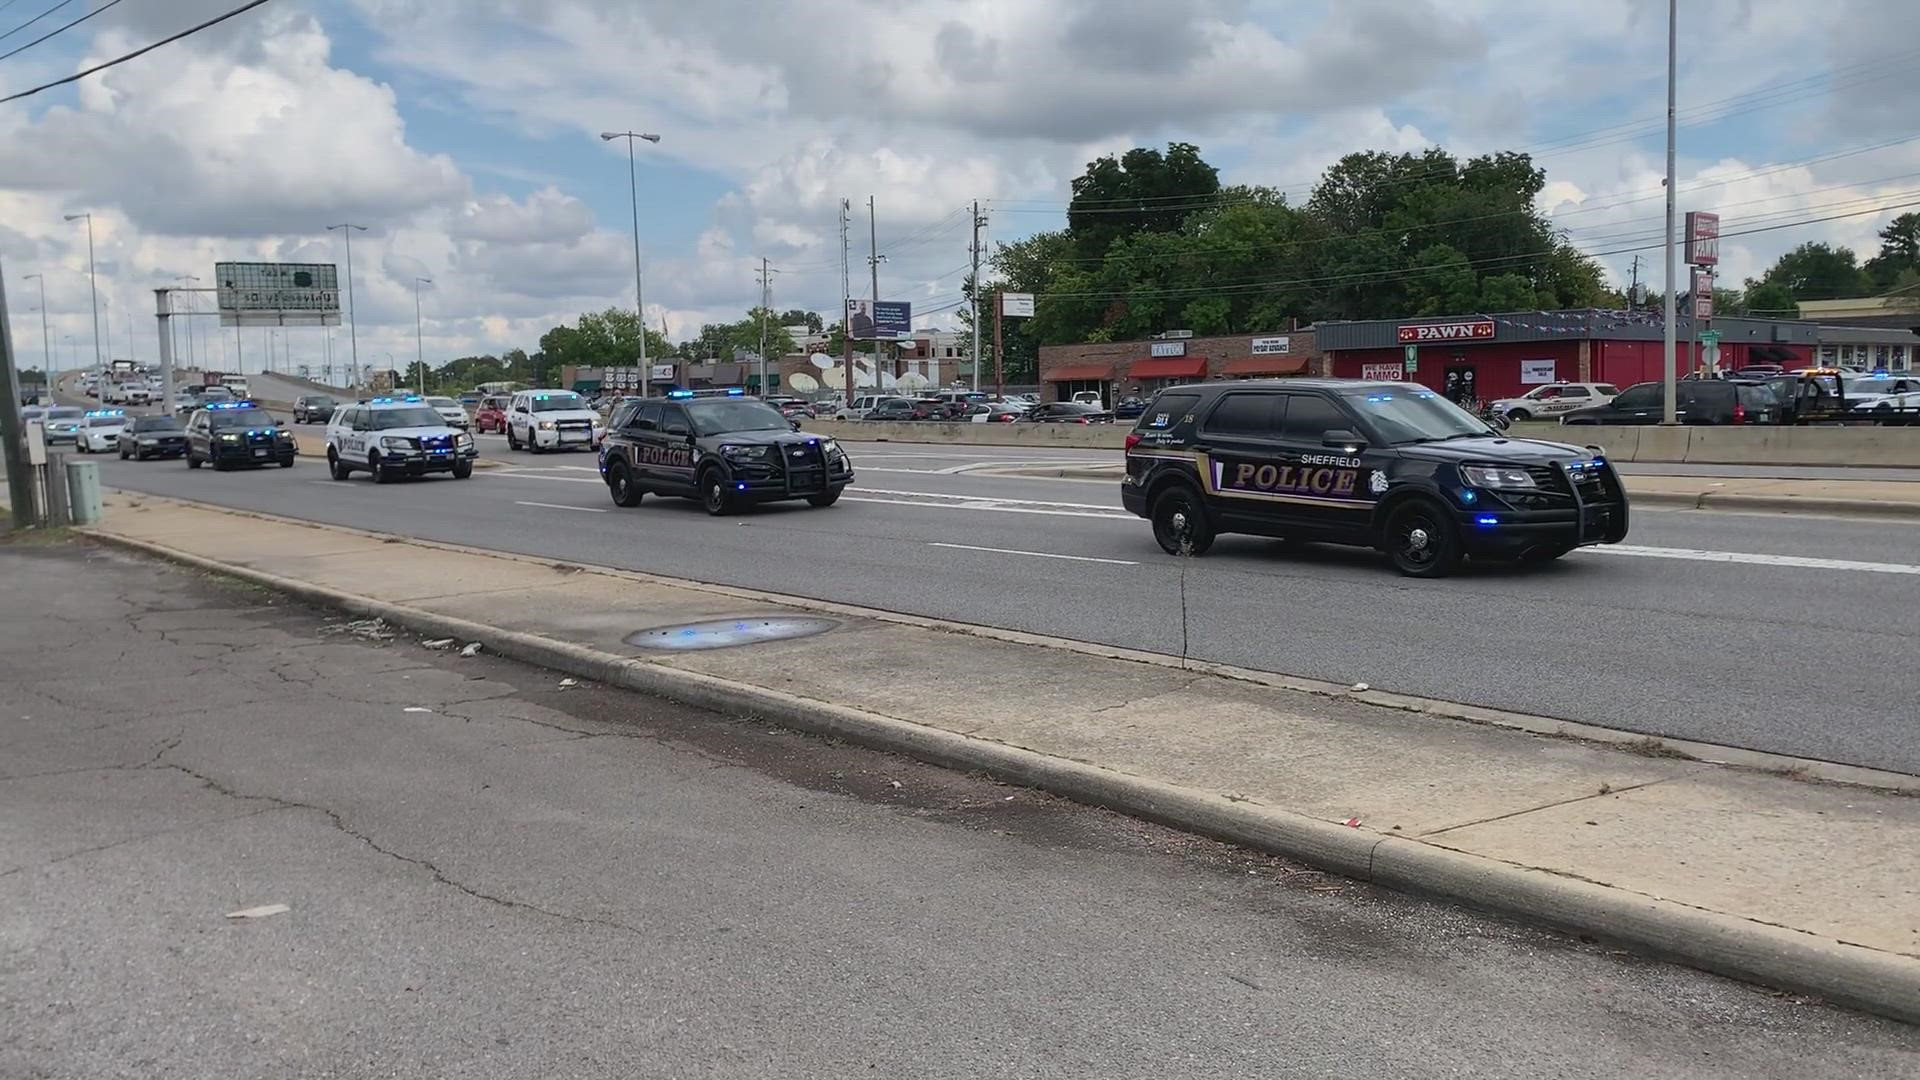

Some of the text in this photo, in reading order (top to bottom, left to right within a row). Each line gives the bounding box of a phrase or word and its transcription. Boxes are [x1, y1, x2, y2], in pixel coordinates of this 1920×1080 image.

[1417, 325, 1475, 339] PAWN
[1366, 370, 1400, 380] AMMO
[642, 447, 690, 466] POLICE
[1301, 454, 1361, 468] SHEFFIELD
[1234, 463, 1358, 493] POLICE
